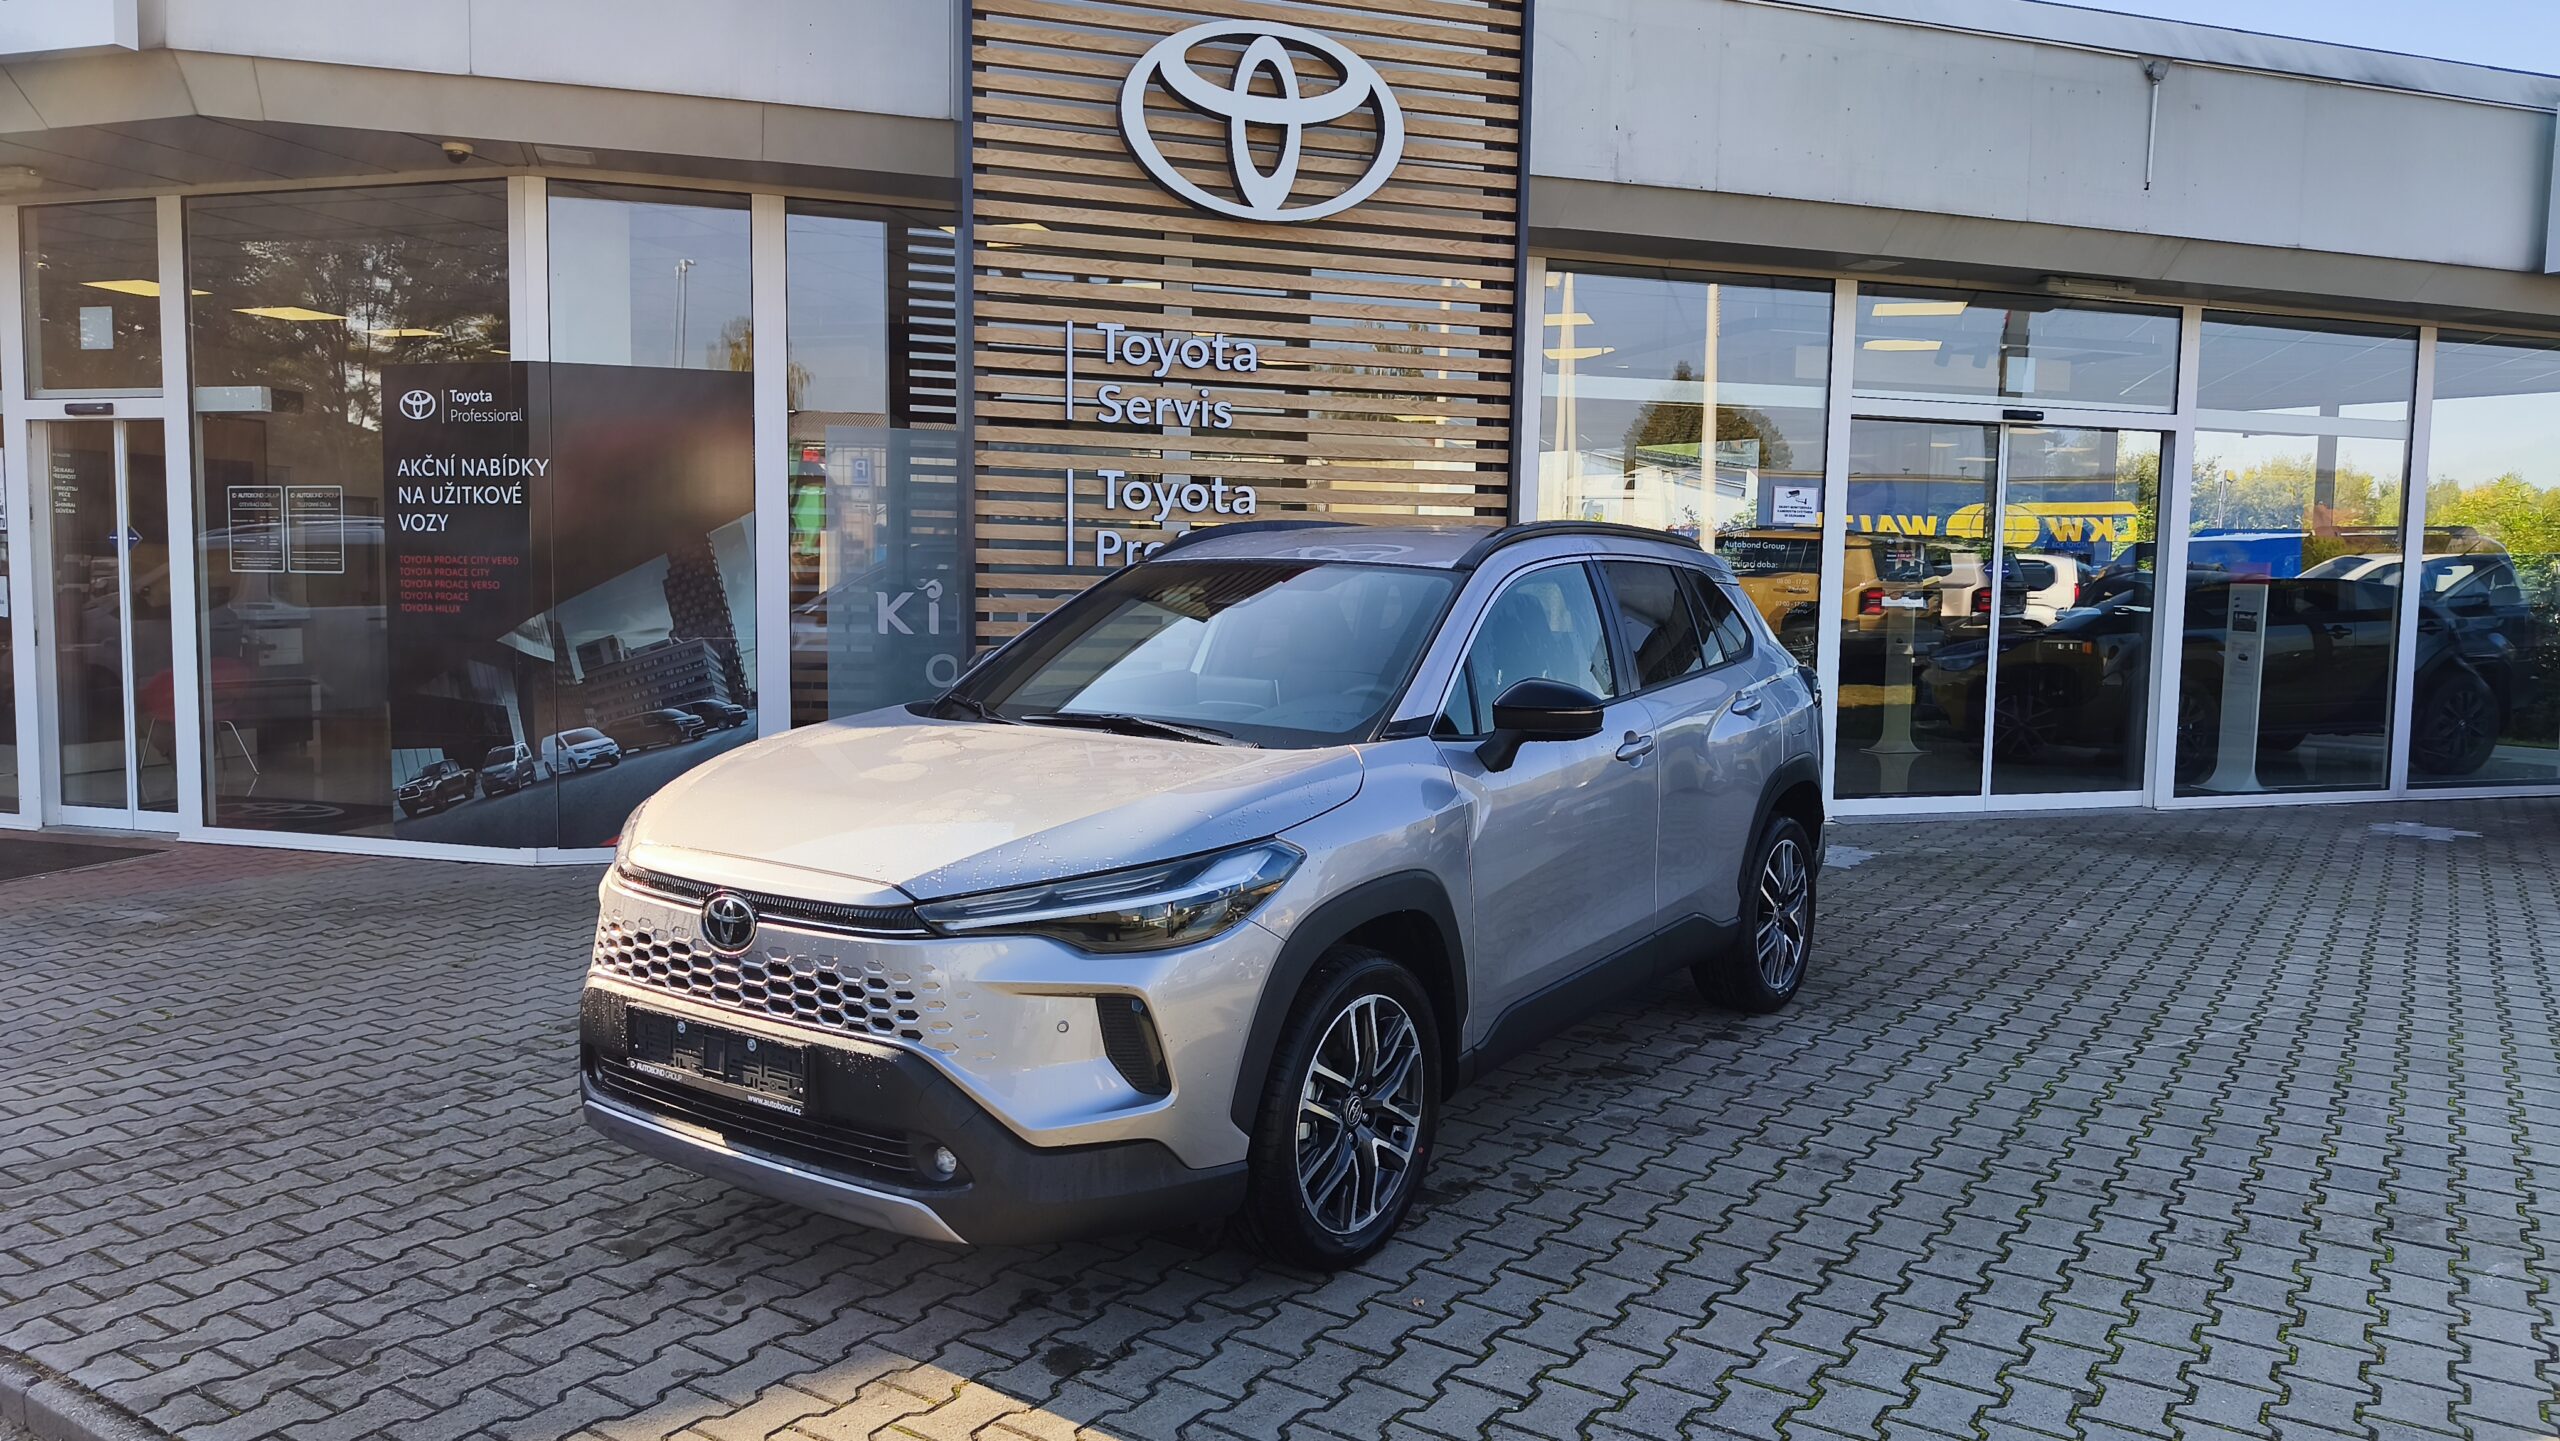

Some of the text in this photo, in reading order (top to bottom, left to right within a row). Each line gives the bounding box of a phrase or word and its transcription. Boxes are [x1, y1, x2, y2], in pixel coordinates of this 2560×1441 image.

[1097, 322, 1258, 378] Toyota
[450, 389, 493, 405] Toyota
[1097, 384, 1234, 429] Servis
[450, 408, 523, 422] Professional
[397, 454, 549, 477] AKČNÍ NABÍDKY
[398, 481, 522, 504] NA UŽITKOVÉ
[1097, 469, 1257, 522] Toyota
[397, 513, 449, 532] VOZY
[1724, 540, 1786, 551] Autobond Group
[400, 555, 519, 565] TOYOTA PROACE CITY VERSO
[1726, 559, 1778, 569] tevírací doba:
[400, 567, 490, 577] TOYOTA PROACE CITY
[400, 579, 500, 590] TOYOTA PROACE VERSO
[400, 591, 469, 601] TOYOTA PROACE
[400, 603, 461, 613] TOYOTA HILUX
[747, 1094, 802, 1116] www.autobond.cz
